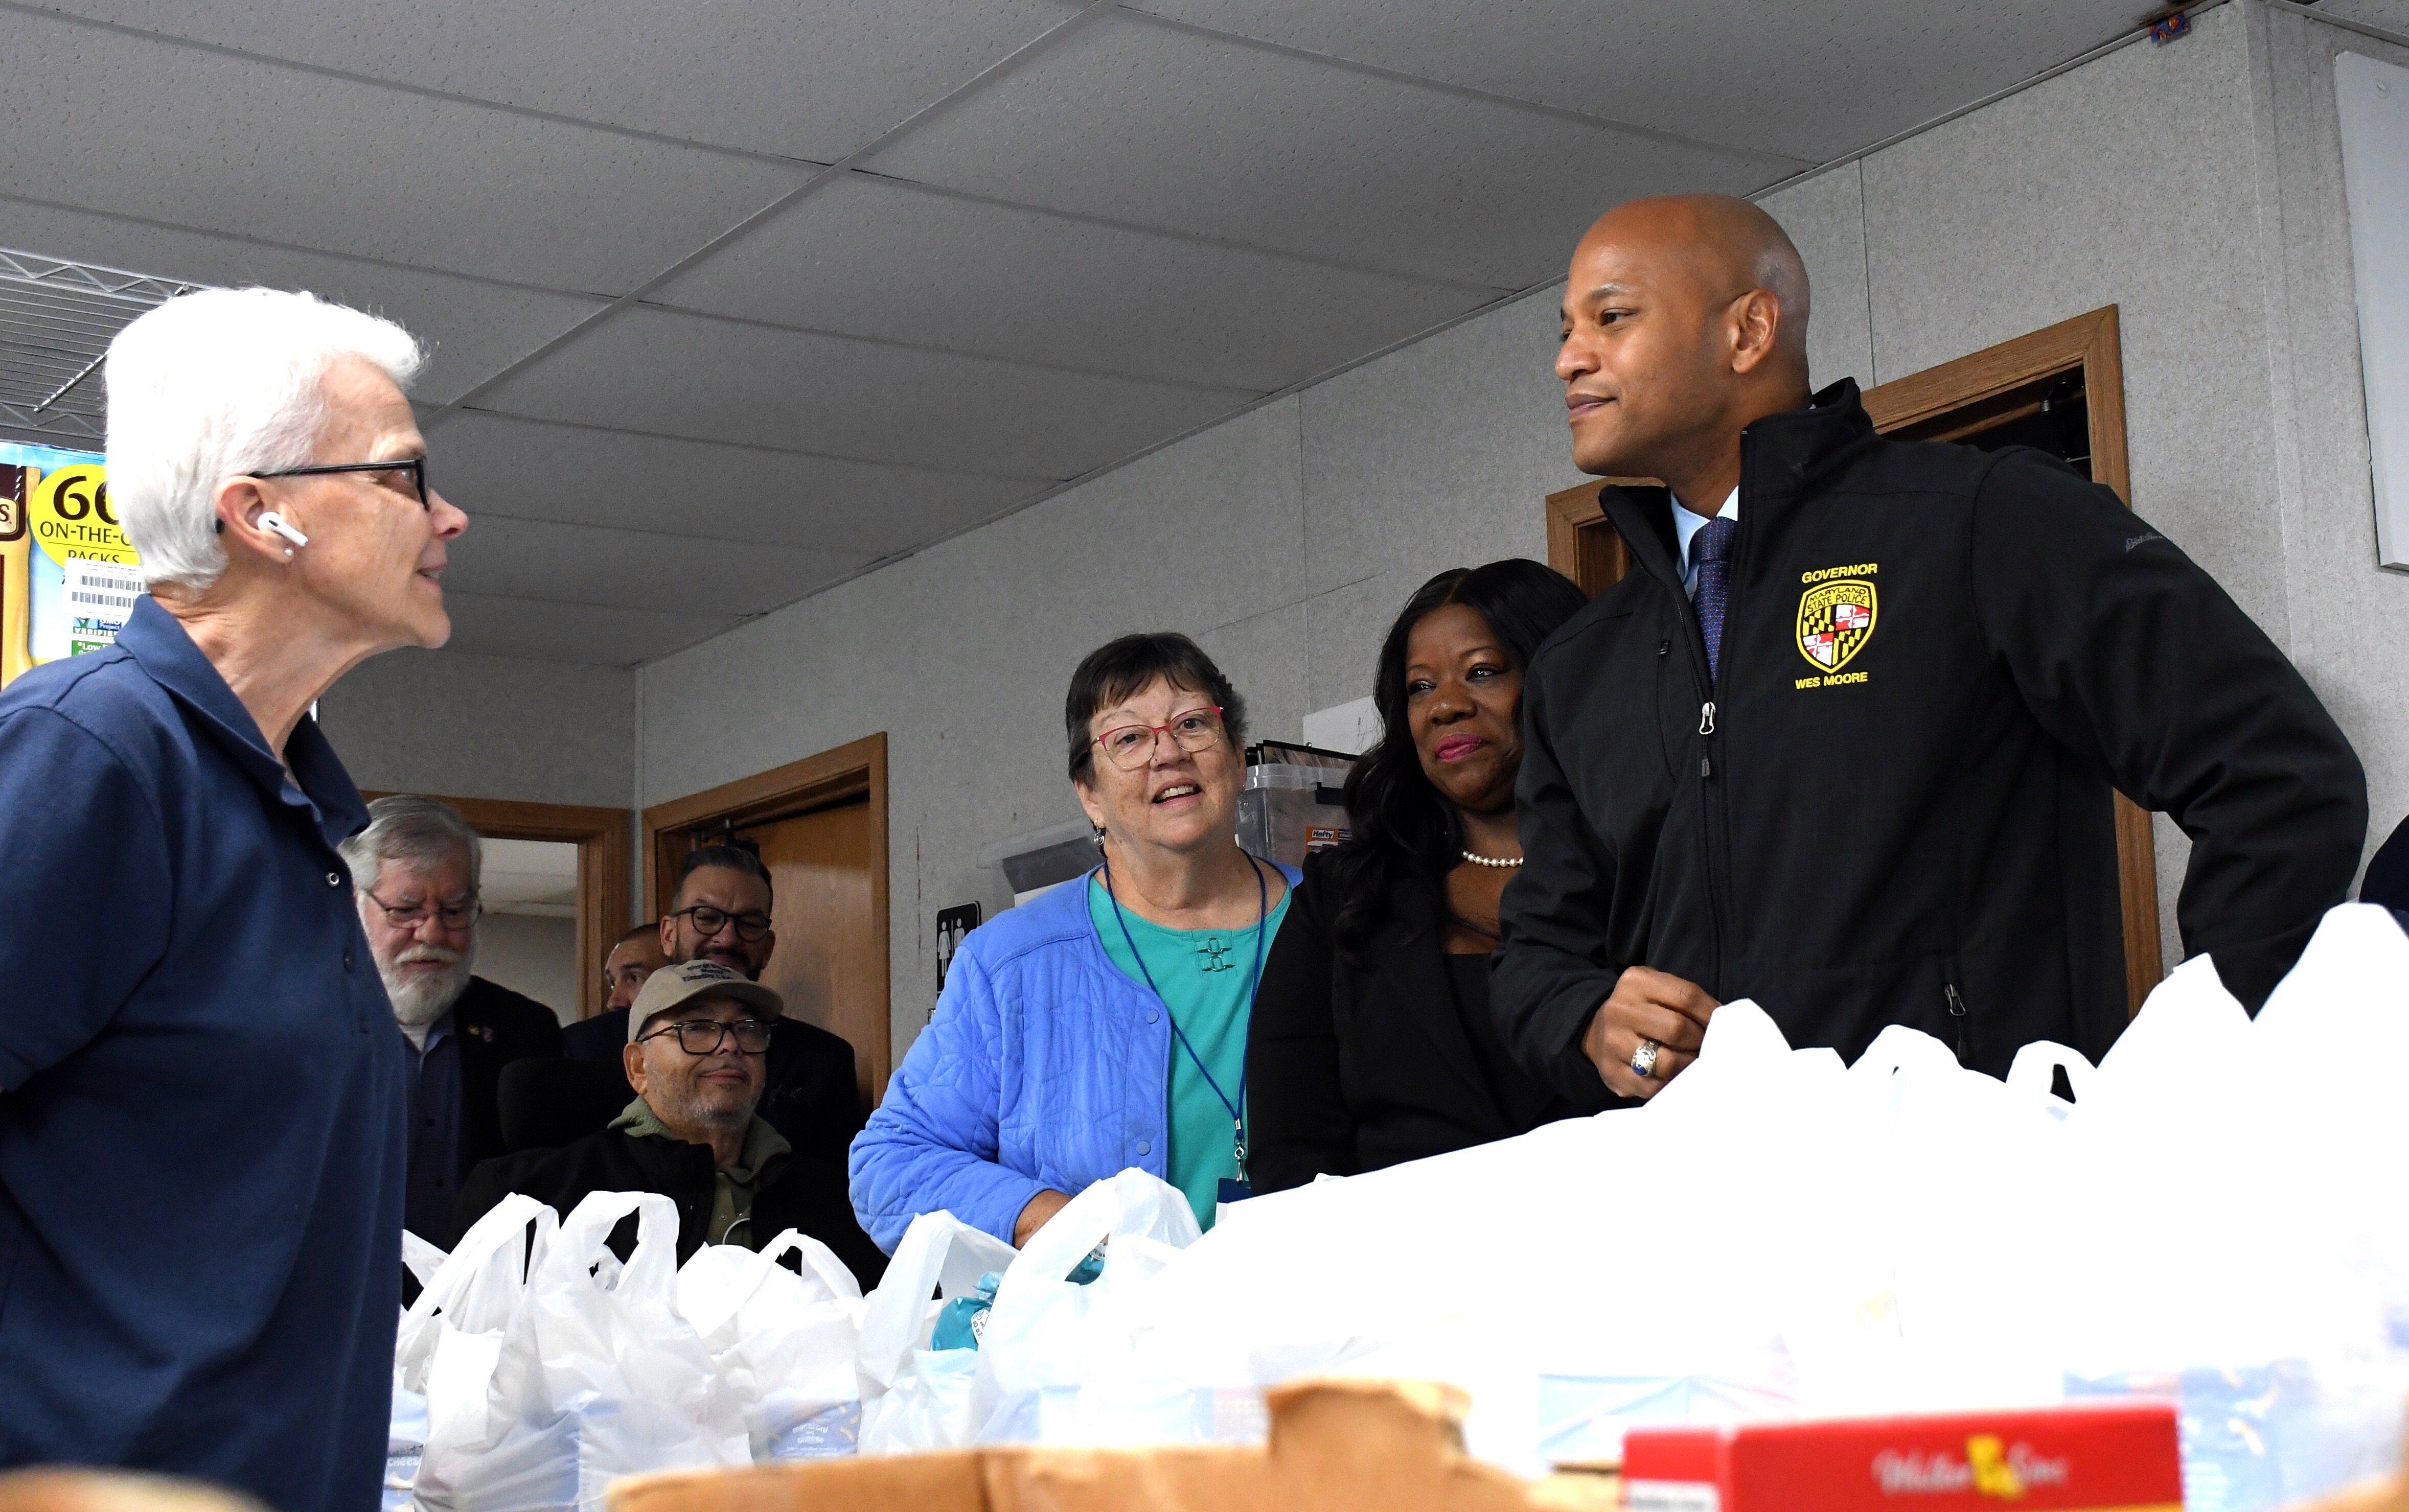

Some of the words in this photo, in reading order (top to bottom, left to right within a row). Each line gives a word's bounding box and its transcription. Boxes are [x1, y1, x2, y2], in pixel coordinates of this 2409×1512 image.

[1802, 563, 1878, 584] GOVERNOR
[1807, 596, 1832, 612] STATE
[1836, 594, 1868, 604] POLICE
[1810, 588, 1866, 602] MARYLAND
[1795, 677, 1820, 689] WES
[1824, 672, 1868, 686] MOORE
[1313, 830, 1333, 839] Hefty
